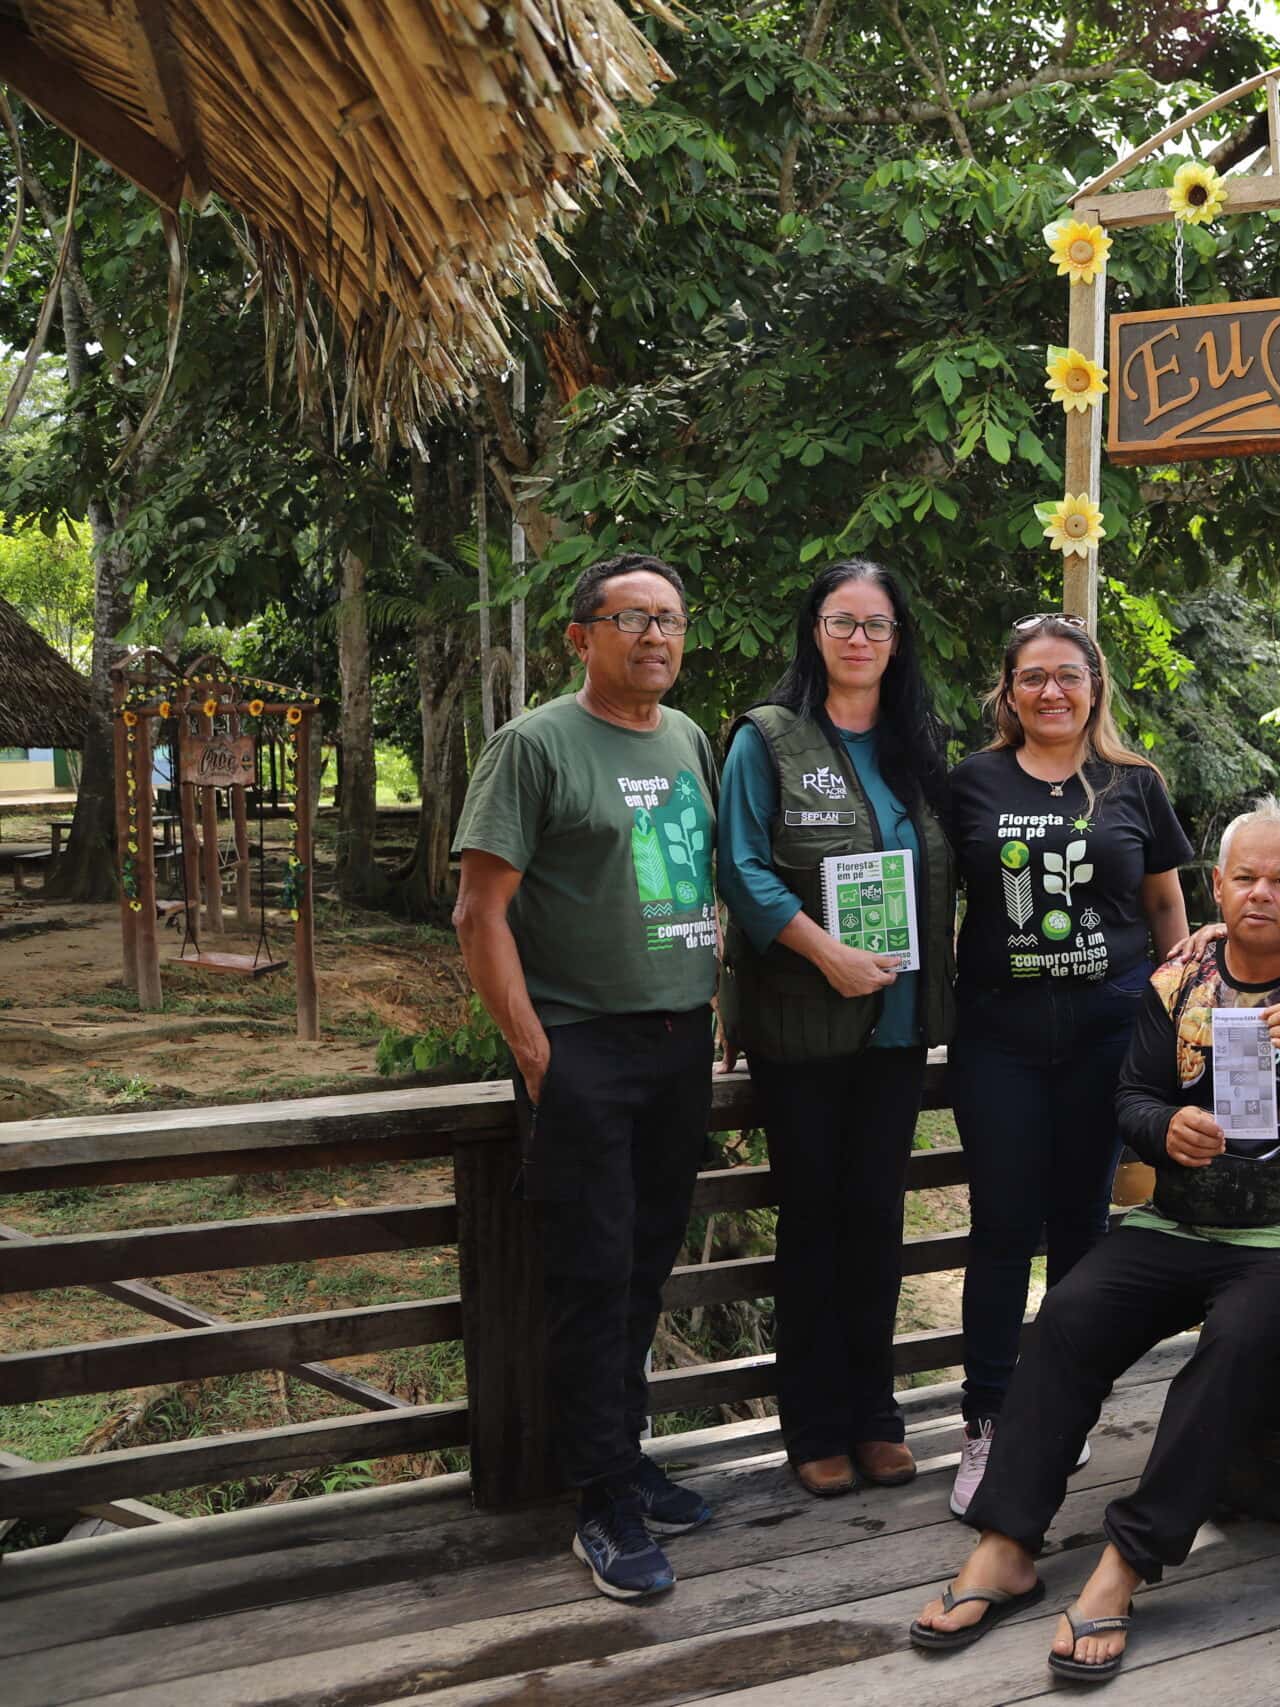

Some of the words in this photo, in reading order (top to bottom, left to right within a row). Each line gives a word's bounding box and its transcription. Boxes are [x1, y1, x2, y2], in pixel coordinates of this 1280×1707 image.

[1124, 320, 1255, 427] Eu
[617, 776, 670, 793] Floresta
[803, 773, 847, 794] REM
[624, 795, 643, 807] em
[644, 792, 659, 810] pé
[801, 811, 839, 820] SEPLAN
[999, 814, 1064, 826] Floresta
[997, 827, 1021, 838] em
[1026, 824, 1046, 840] pé
[836, 860, 874, 872] Floresta
[837, 872, 851, 880] em
[861, 888, 882, 898] REM
[658, 917, 717, 938] compromis
[686, 935, 698, 948] de
[1075, 932, 1084, 948] é
[1087, 932, 1105, 946] um
[1015, 946, 1108, 968] compromisso
[1051, 964, 1069, 977] de
[1072, 959, 1109, 976] todos
